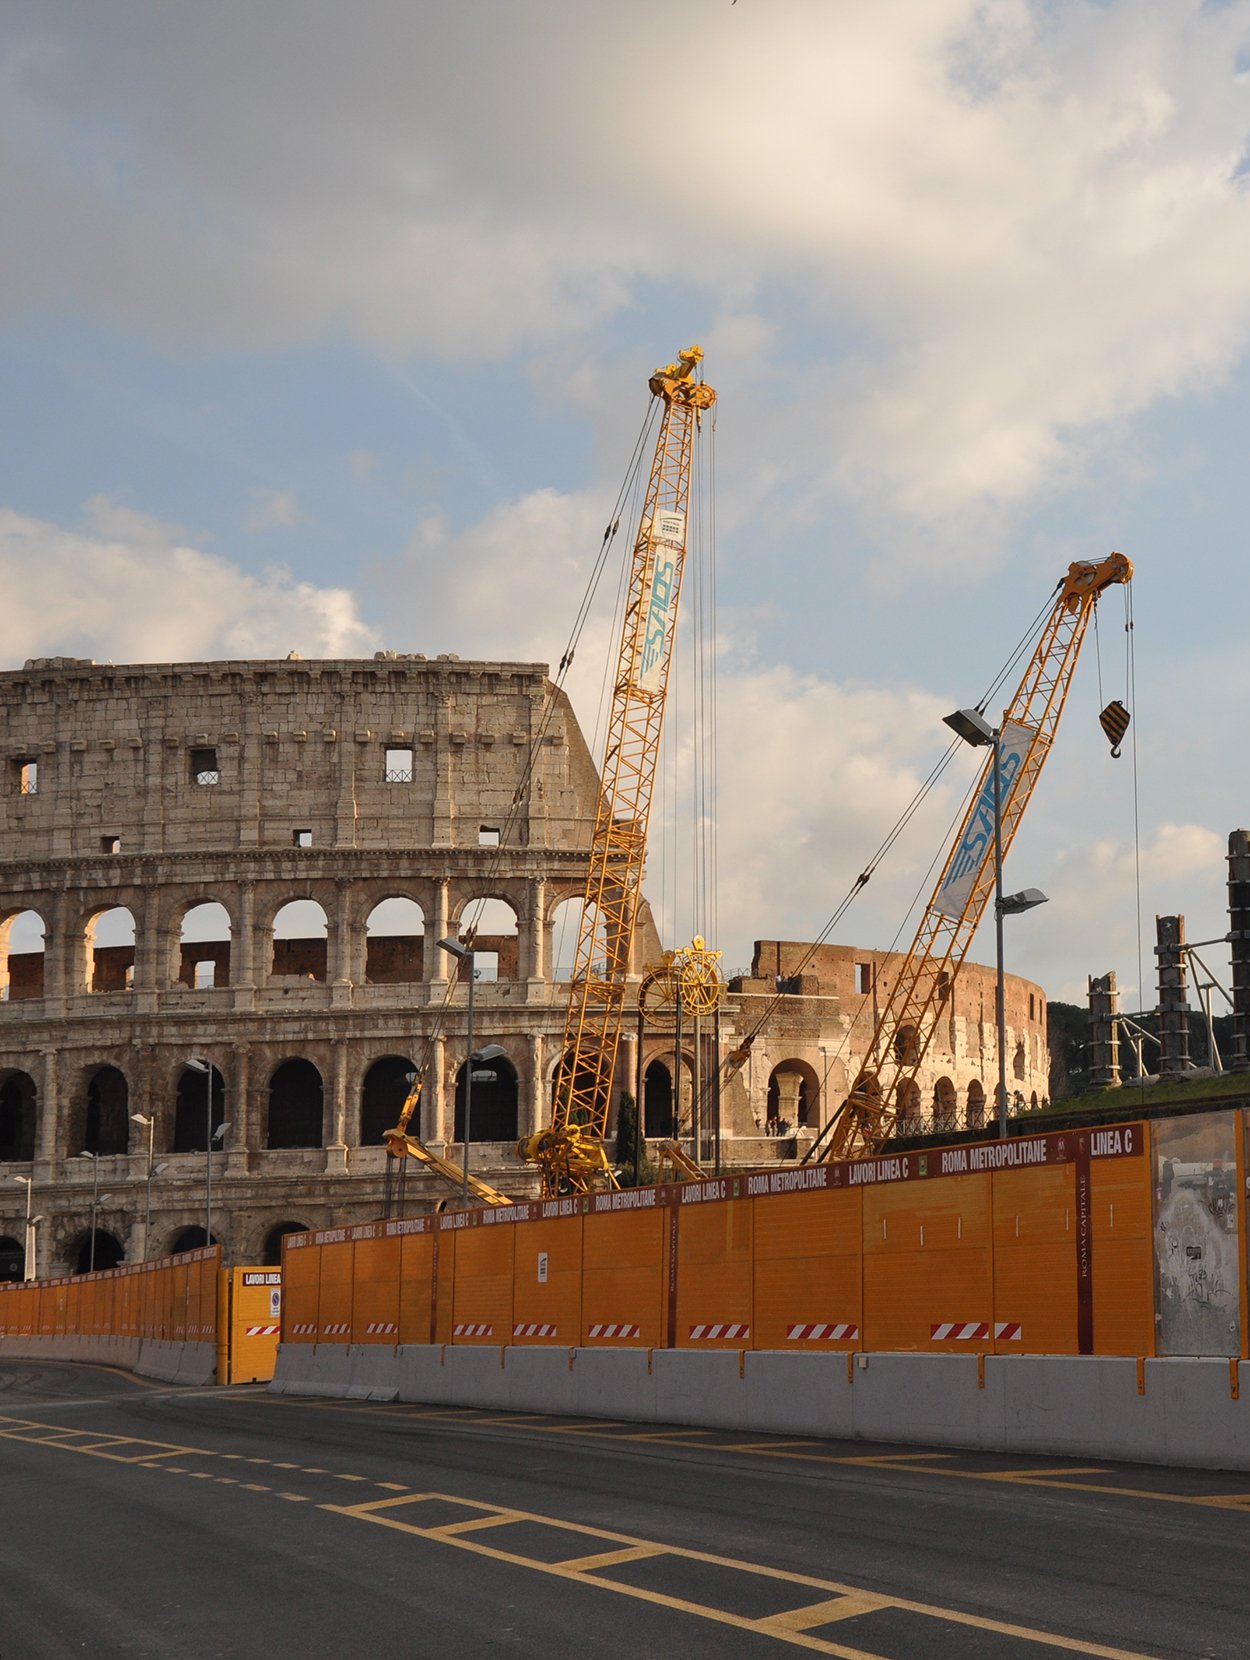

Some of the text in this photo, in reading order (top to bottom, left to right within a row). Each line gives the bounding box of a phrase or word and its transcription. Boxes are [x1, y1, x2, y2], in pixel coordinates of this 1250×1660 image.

[942, 1139, 1047, 1173] ROMA METROPOLITANE
[1090, 1129, 1133, 1156] LINEA C
[748, 1167, 827, 1195] ROMA METROPOLITANE
[849, 1157, 909, 1185] LAVORI LINEA C
[682, 1185, 701, 1203] LAVORI
[720, 1180, 726, 1198] C
